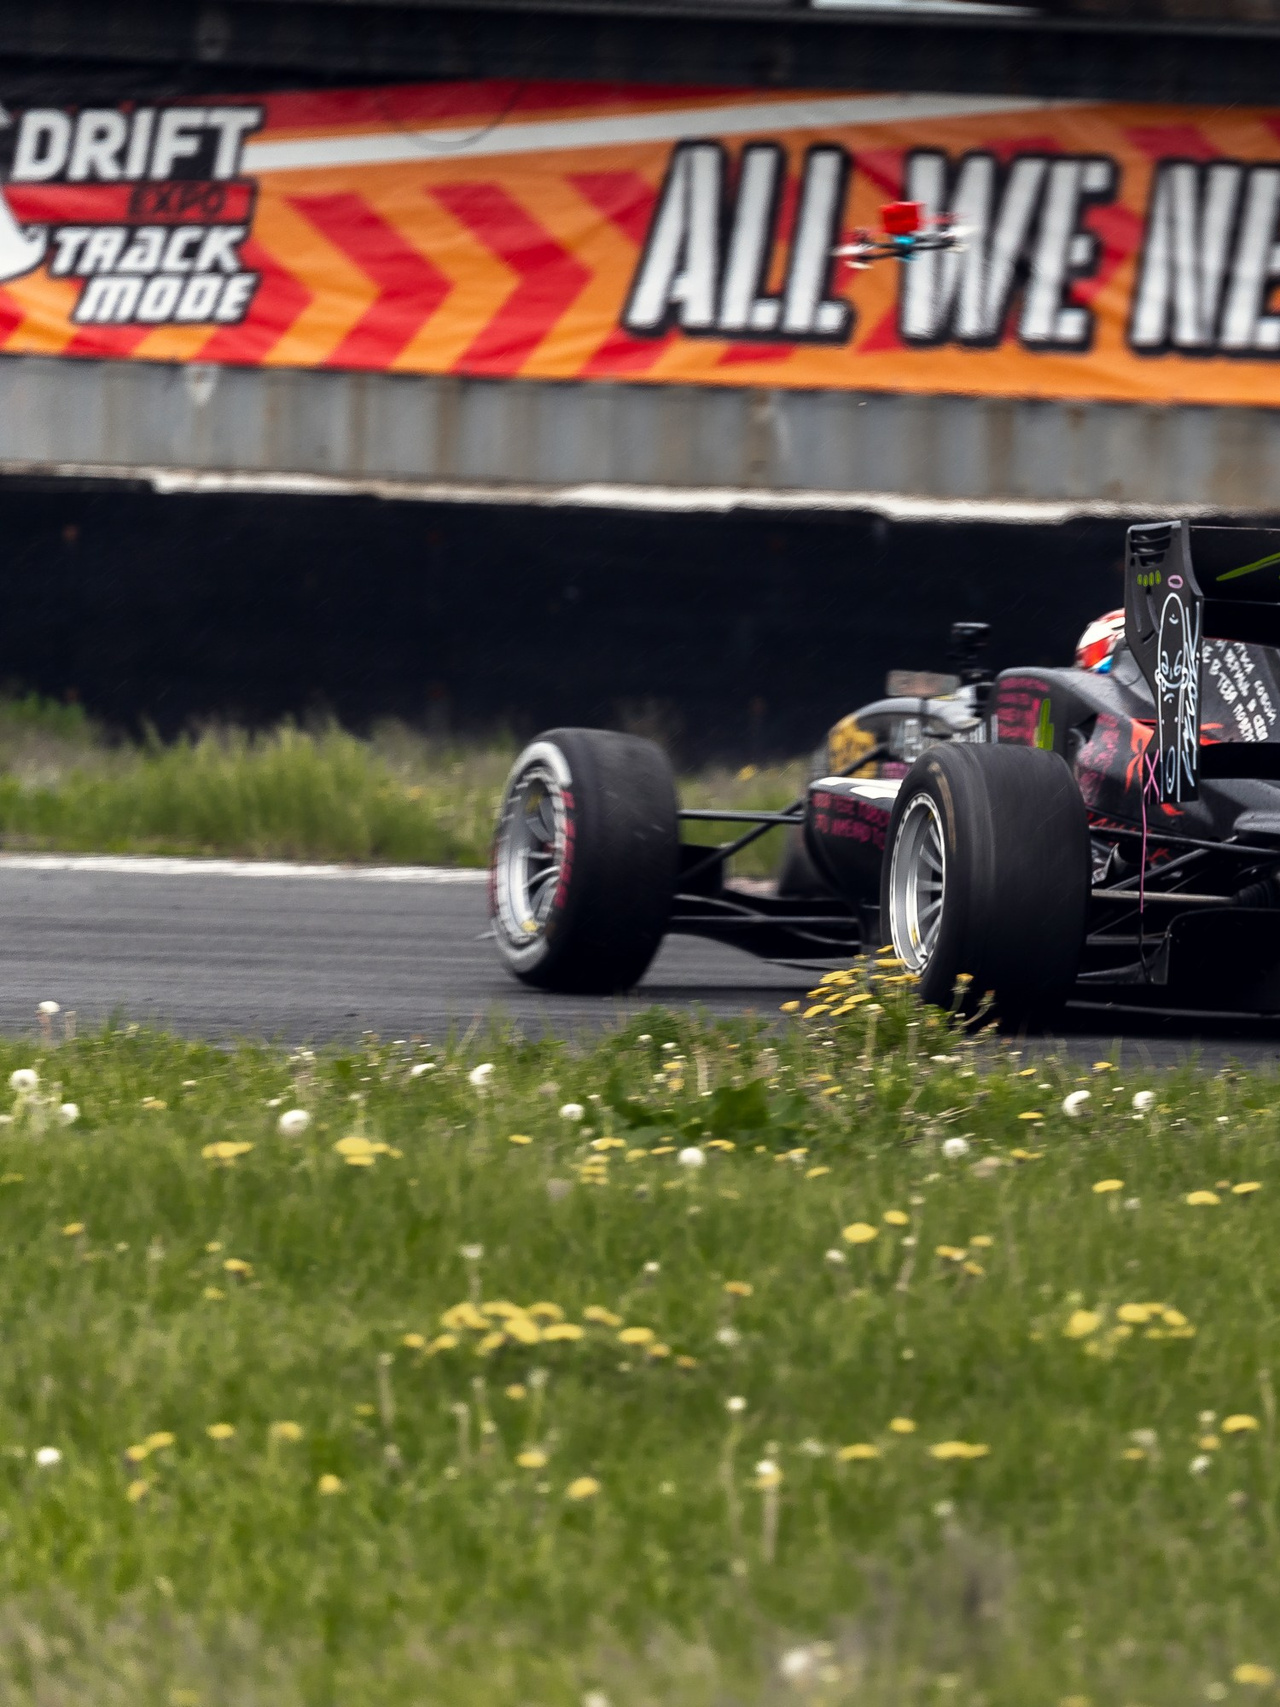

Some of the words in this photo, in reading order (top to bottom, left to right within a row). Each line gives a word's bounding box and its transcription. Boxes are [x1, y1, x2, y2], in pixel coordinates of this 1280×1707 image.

[10, 106, 263, 181] DRIFT
[128, 183, 228, 223] EXPO
[623, 142, 850, 334] ALL
[901, 151, 1113, 345] WE
[73, 272, 258, 322] MODE
